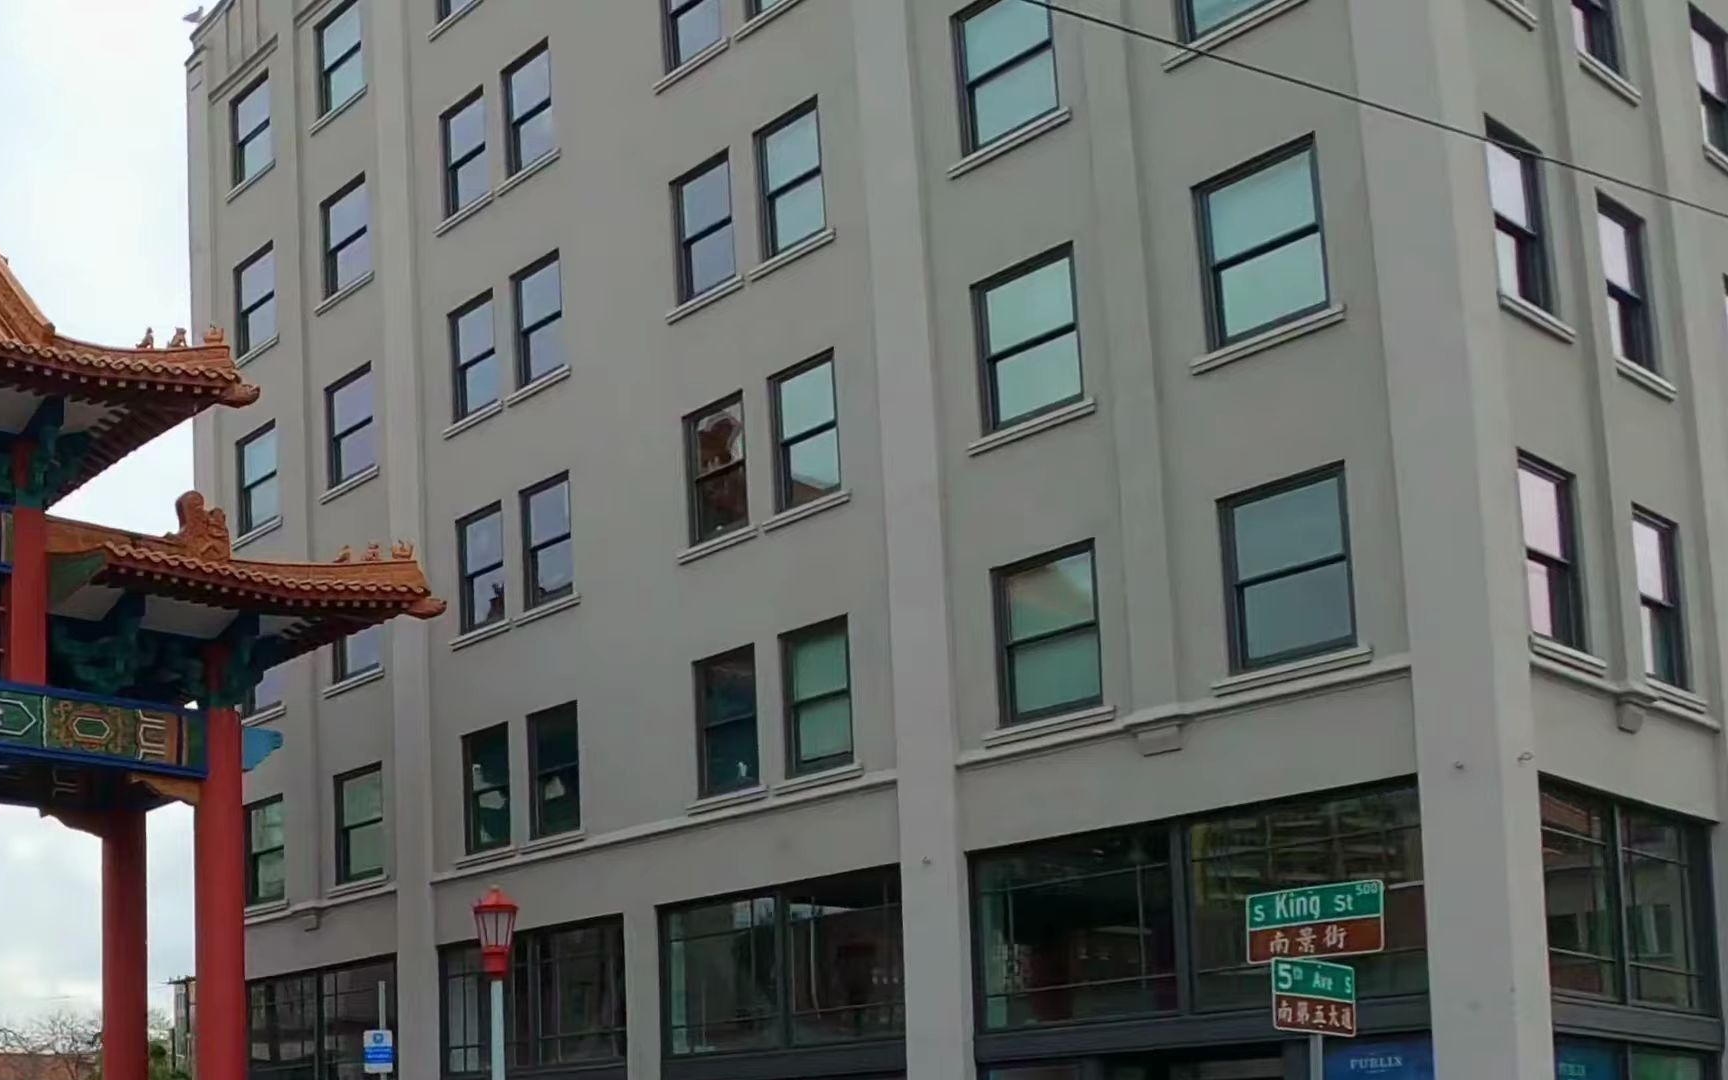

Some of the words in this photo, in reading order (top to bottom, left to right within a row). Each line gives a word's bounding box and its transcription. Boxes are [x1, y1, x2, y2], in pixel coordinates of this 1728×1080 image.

[1253, 904, 1266, 922] S
[1275, 893, 1321, 920] King
[1334, 895, 1354, 912] St
[1269, 925, 1347, 953] 南景街
[1313, 972, 1334, 990] Ave
[1345, 976, 1352, 994] S
